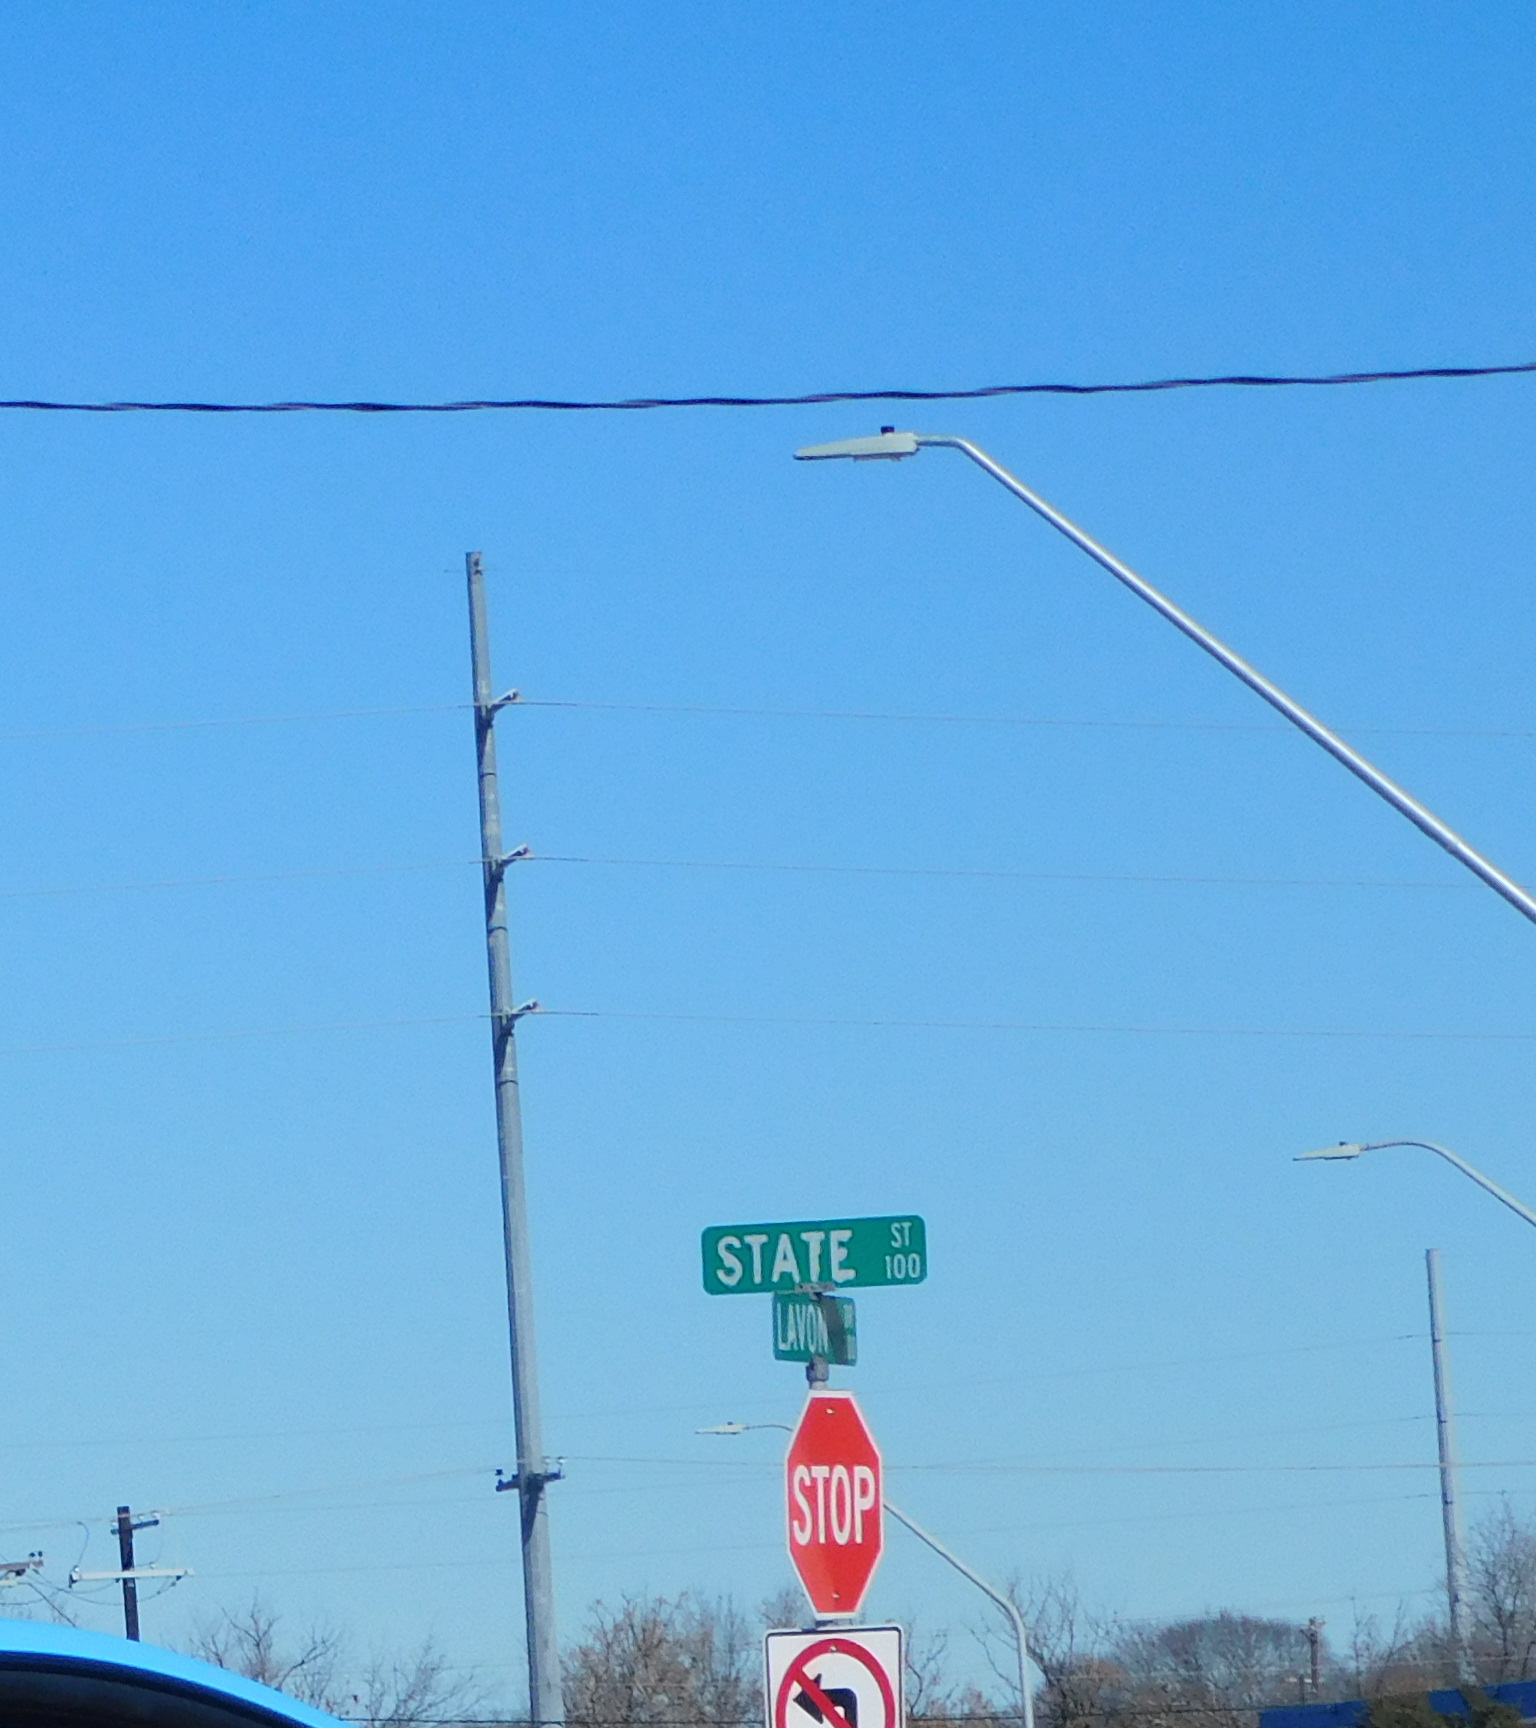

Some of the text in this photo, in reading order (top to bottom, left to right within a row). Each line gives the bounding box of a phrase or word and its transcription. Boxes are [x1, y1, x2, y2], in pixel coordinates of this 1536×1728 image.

[716, 1221, 913, 1287] STATE ST
[884, 1252, 922, 1280] 100
[776, 1301, 830, 1355] LAVON
[792, 1464, 876, 1546] STOP
